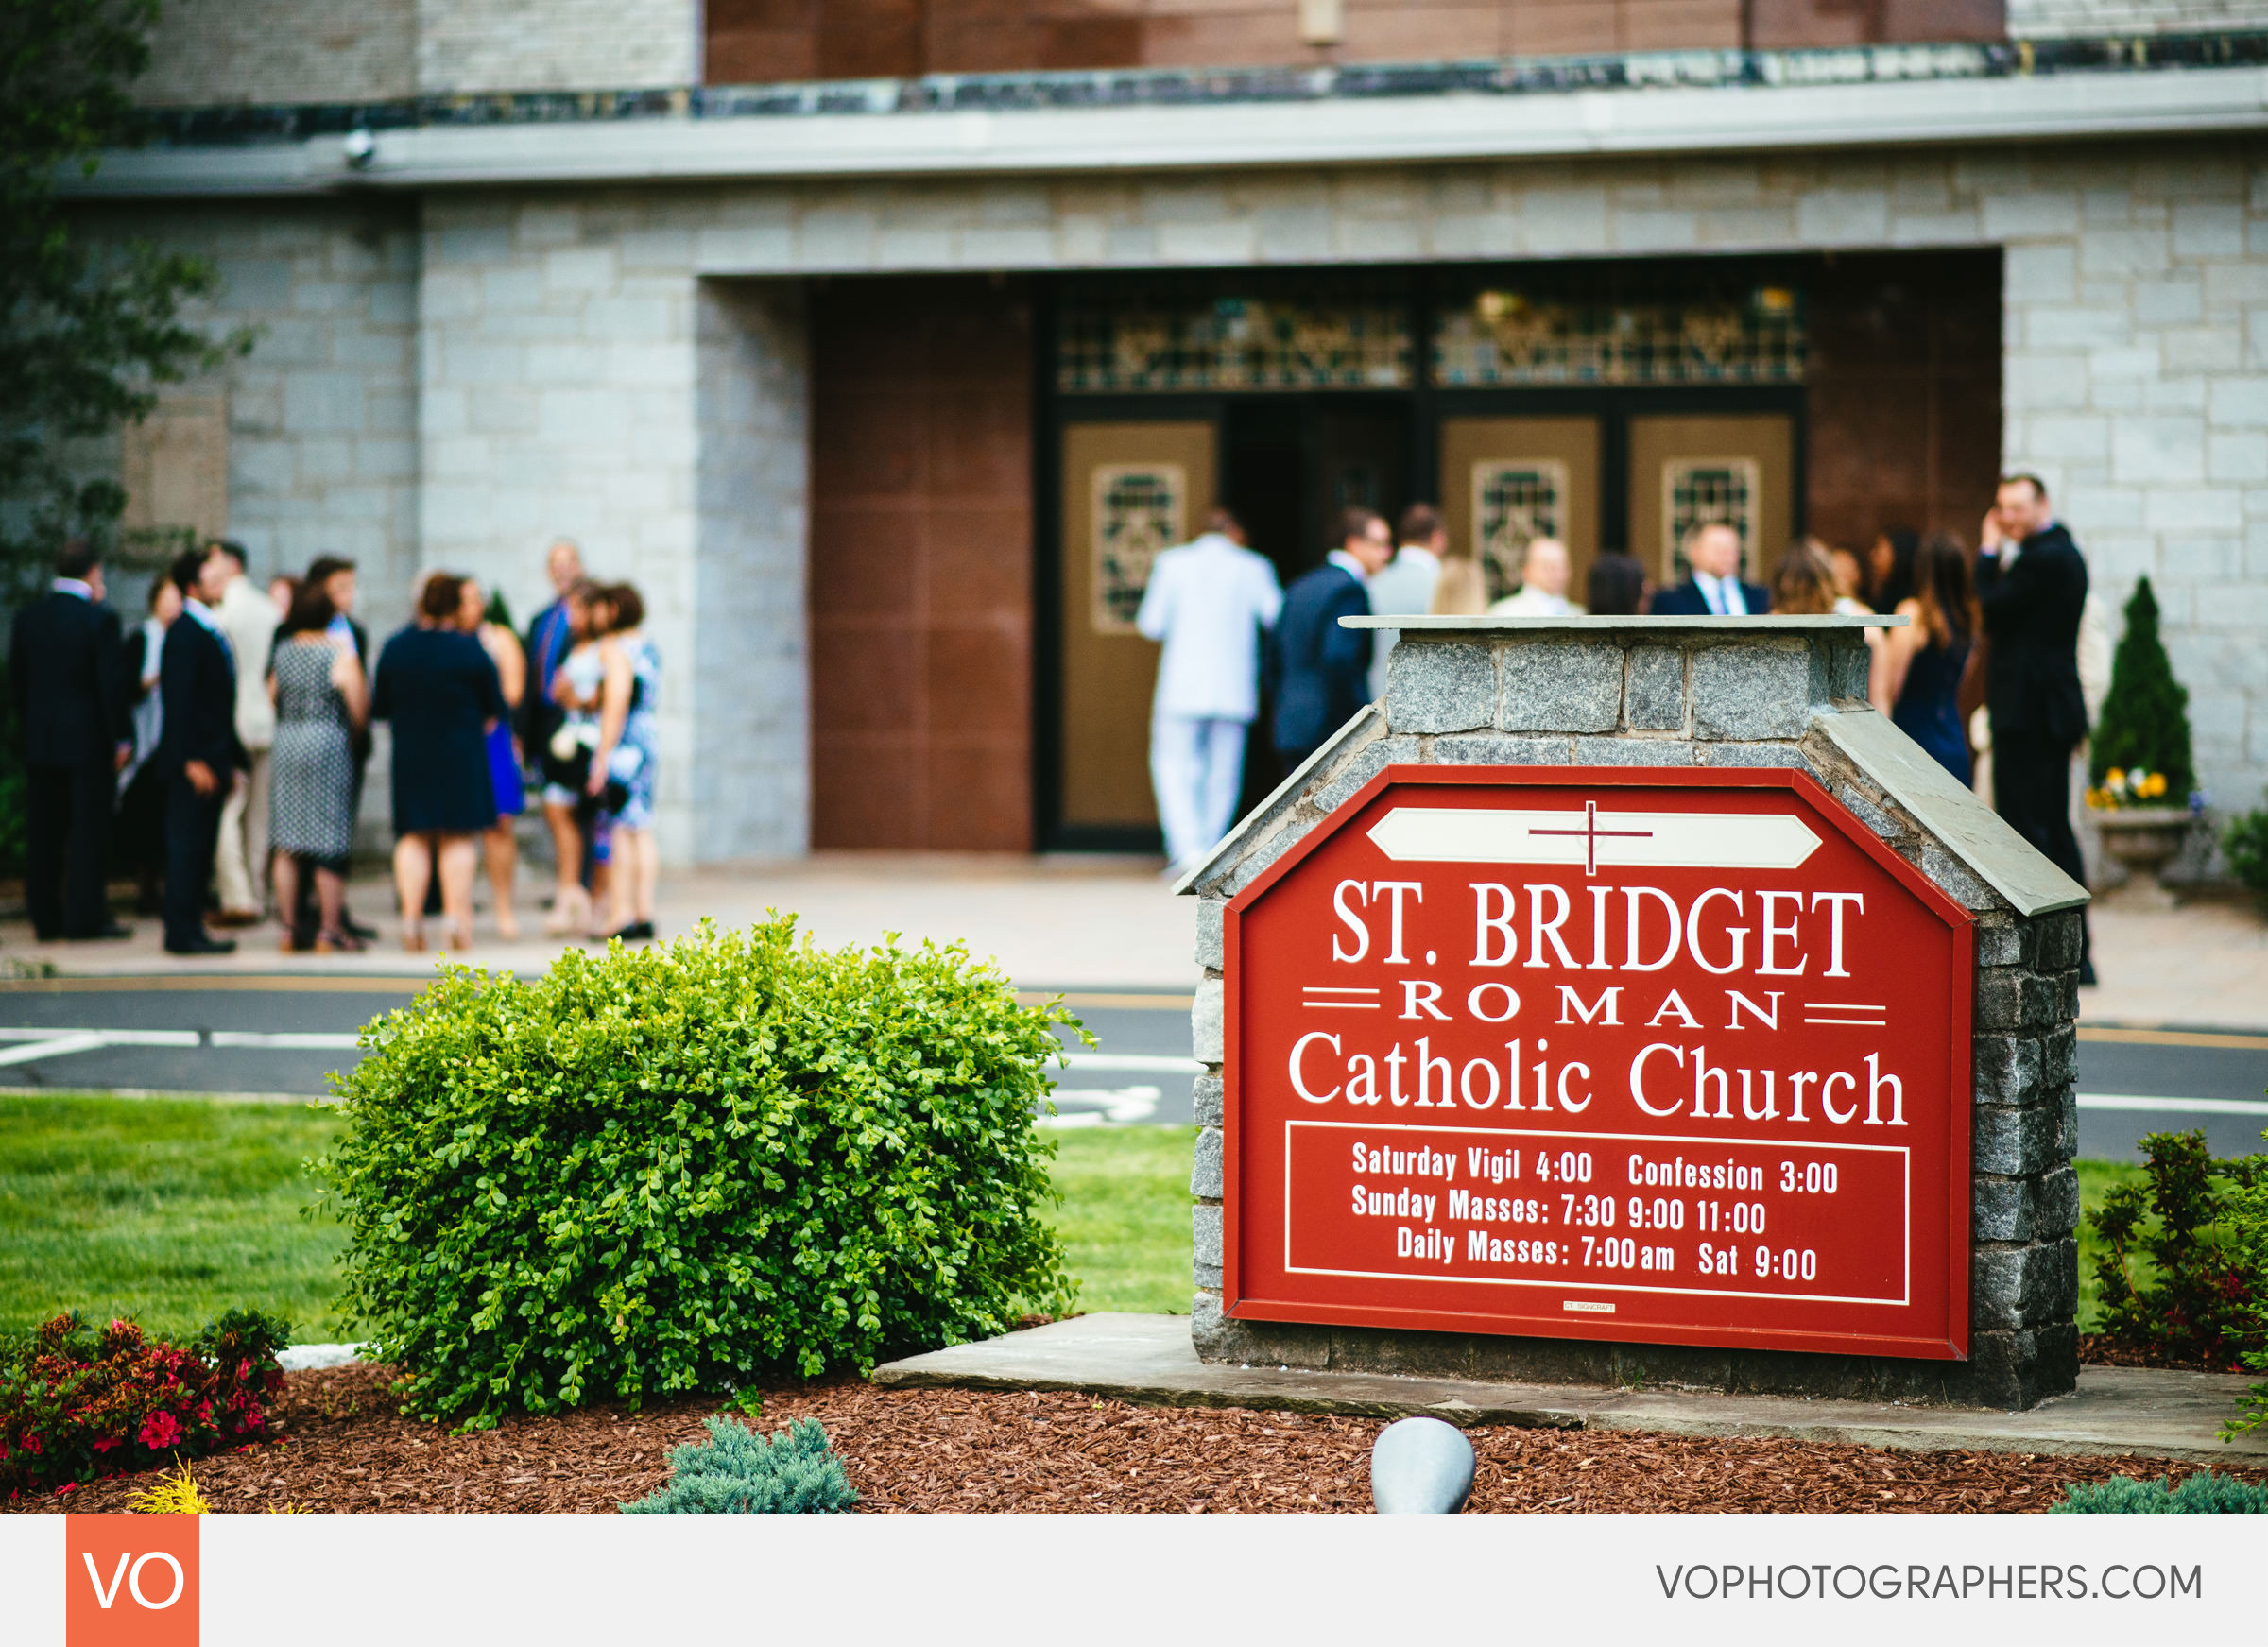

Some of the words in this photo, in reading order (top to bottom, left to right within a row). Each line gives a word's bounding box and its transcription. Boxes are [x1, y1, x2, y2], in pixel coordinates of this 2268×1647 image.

[1332, 879, 1437, 966] ST.
[1469, 882, 1864, 978] BRIDGET
[1398, 980, 1785, 1031] ROMAN
[1288, 1031, 1592, 1114] Catholic
[1629, 1042, 1909, 1126] Church
[1352, 1141, 1457, 1182] Saturday
[1467, 1146, 1520, 1185] Vigil
[1536, 1151, 1592, 1183] 4:00
[1628, 1154, 1763, 1191] Confession
[1779, 1160, 1838, 1194] 3:00
[1351, 1184, 1436, 1224] Sunday
[1449, 1189, 1549, 1224] Masses:
[1560, 1193, 1616, 1227] 7:30
[1628, 1196, 1685, 1230] 9:00
[1696, 1200, 1766, 1235] 11:00
[1397, 1227, 1455, 1265] Daily
[1467, 1229, 1569, 1266] Masses:
[1698, 1242, 1738, 1276] Sat
[1755, 1245, 1816, 1281] 9:00
